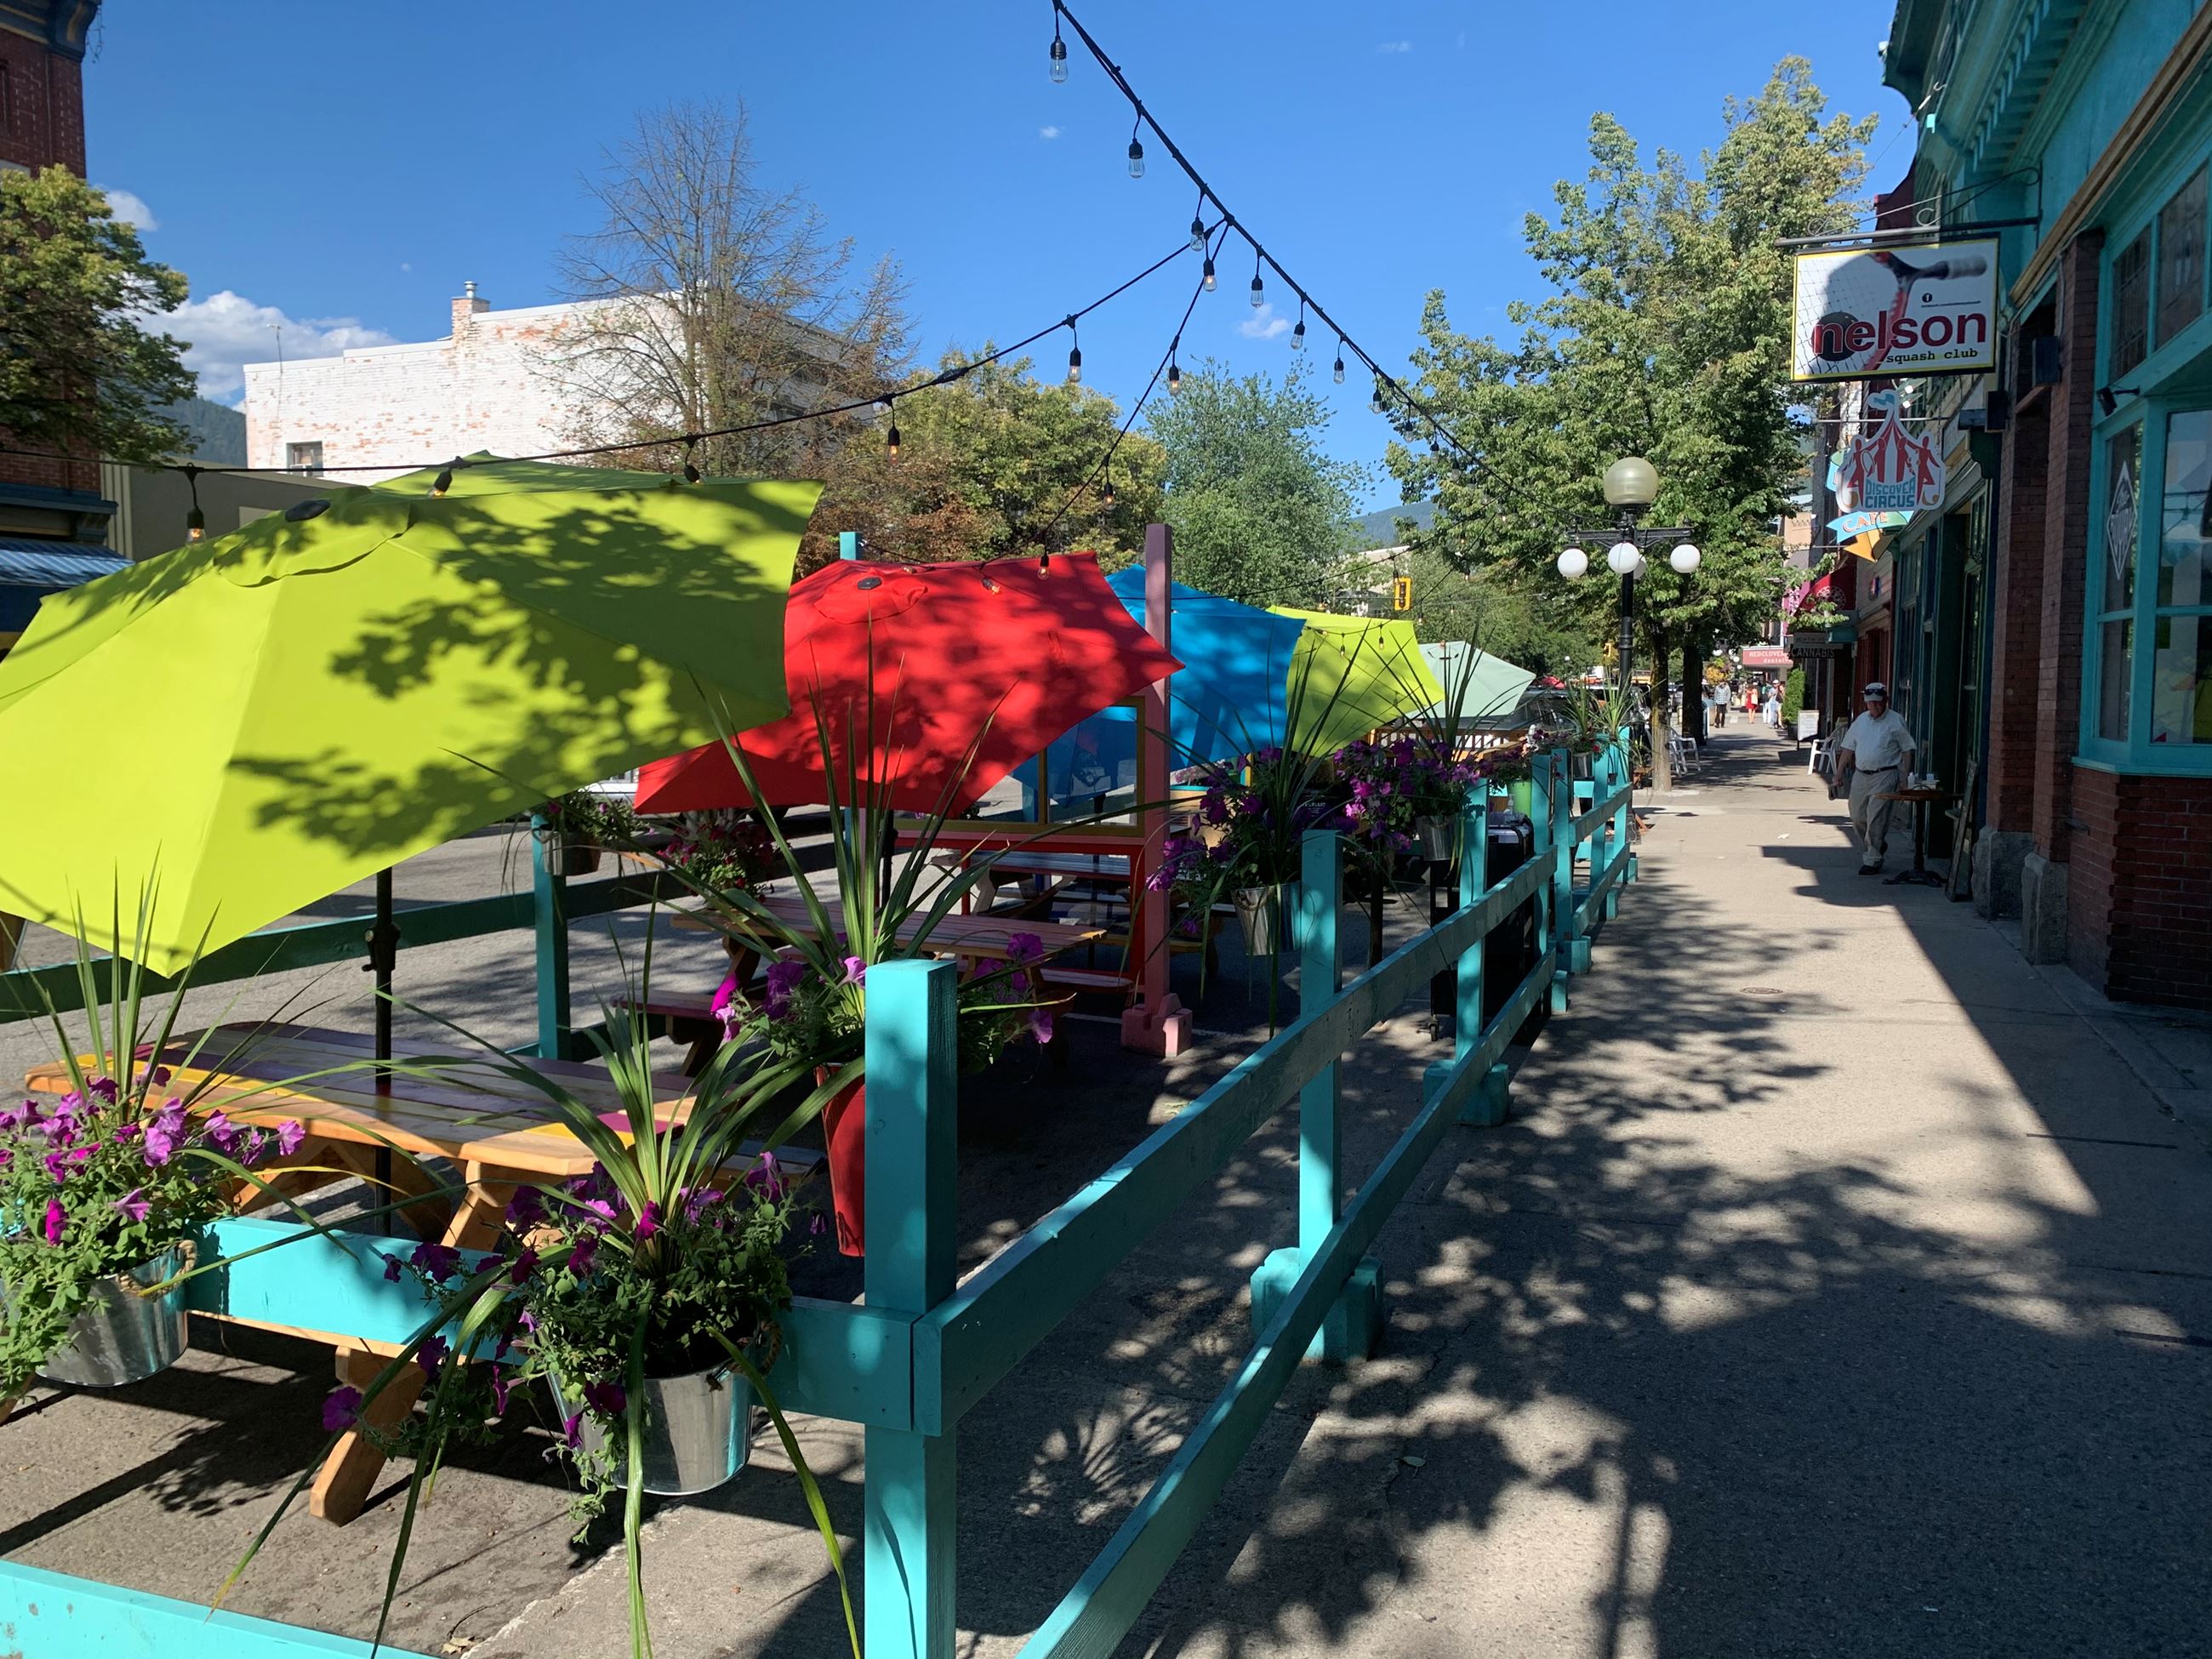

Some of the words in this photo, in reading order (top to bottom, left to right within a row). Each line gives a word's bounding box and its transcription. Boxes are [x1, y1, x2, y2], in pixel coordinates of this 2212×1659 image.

[1814, 311, 1987, 355] nelson
[1886, 351, 1936, 364] squash
[1944, 348, 1978, 359] club
[1866, 477, 1915, 494] DISCOVER
[1865, 495, 1915, 508] CIRCUS
[1791, 647, 1835, 658] CANNABIS
